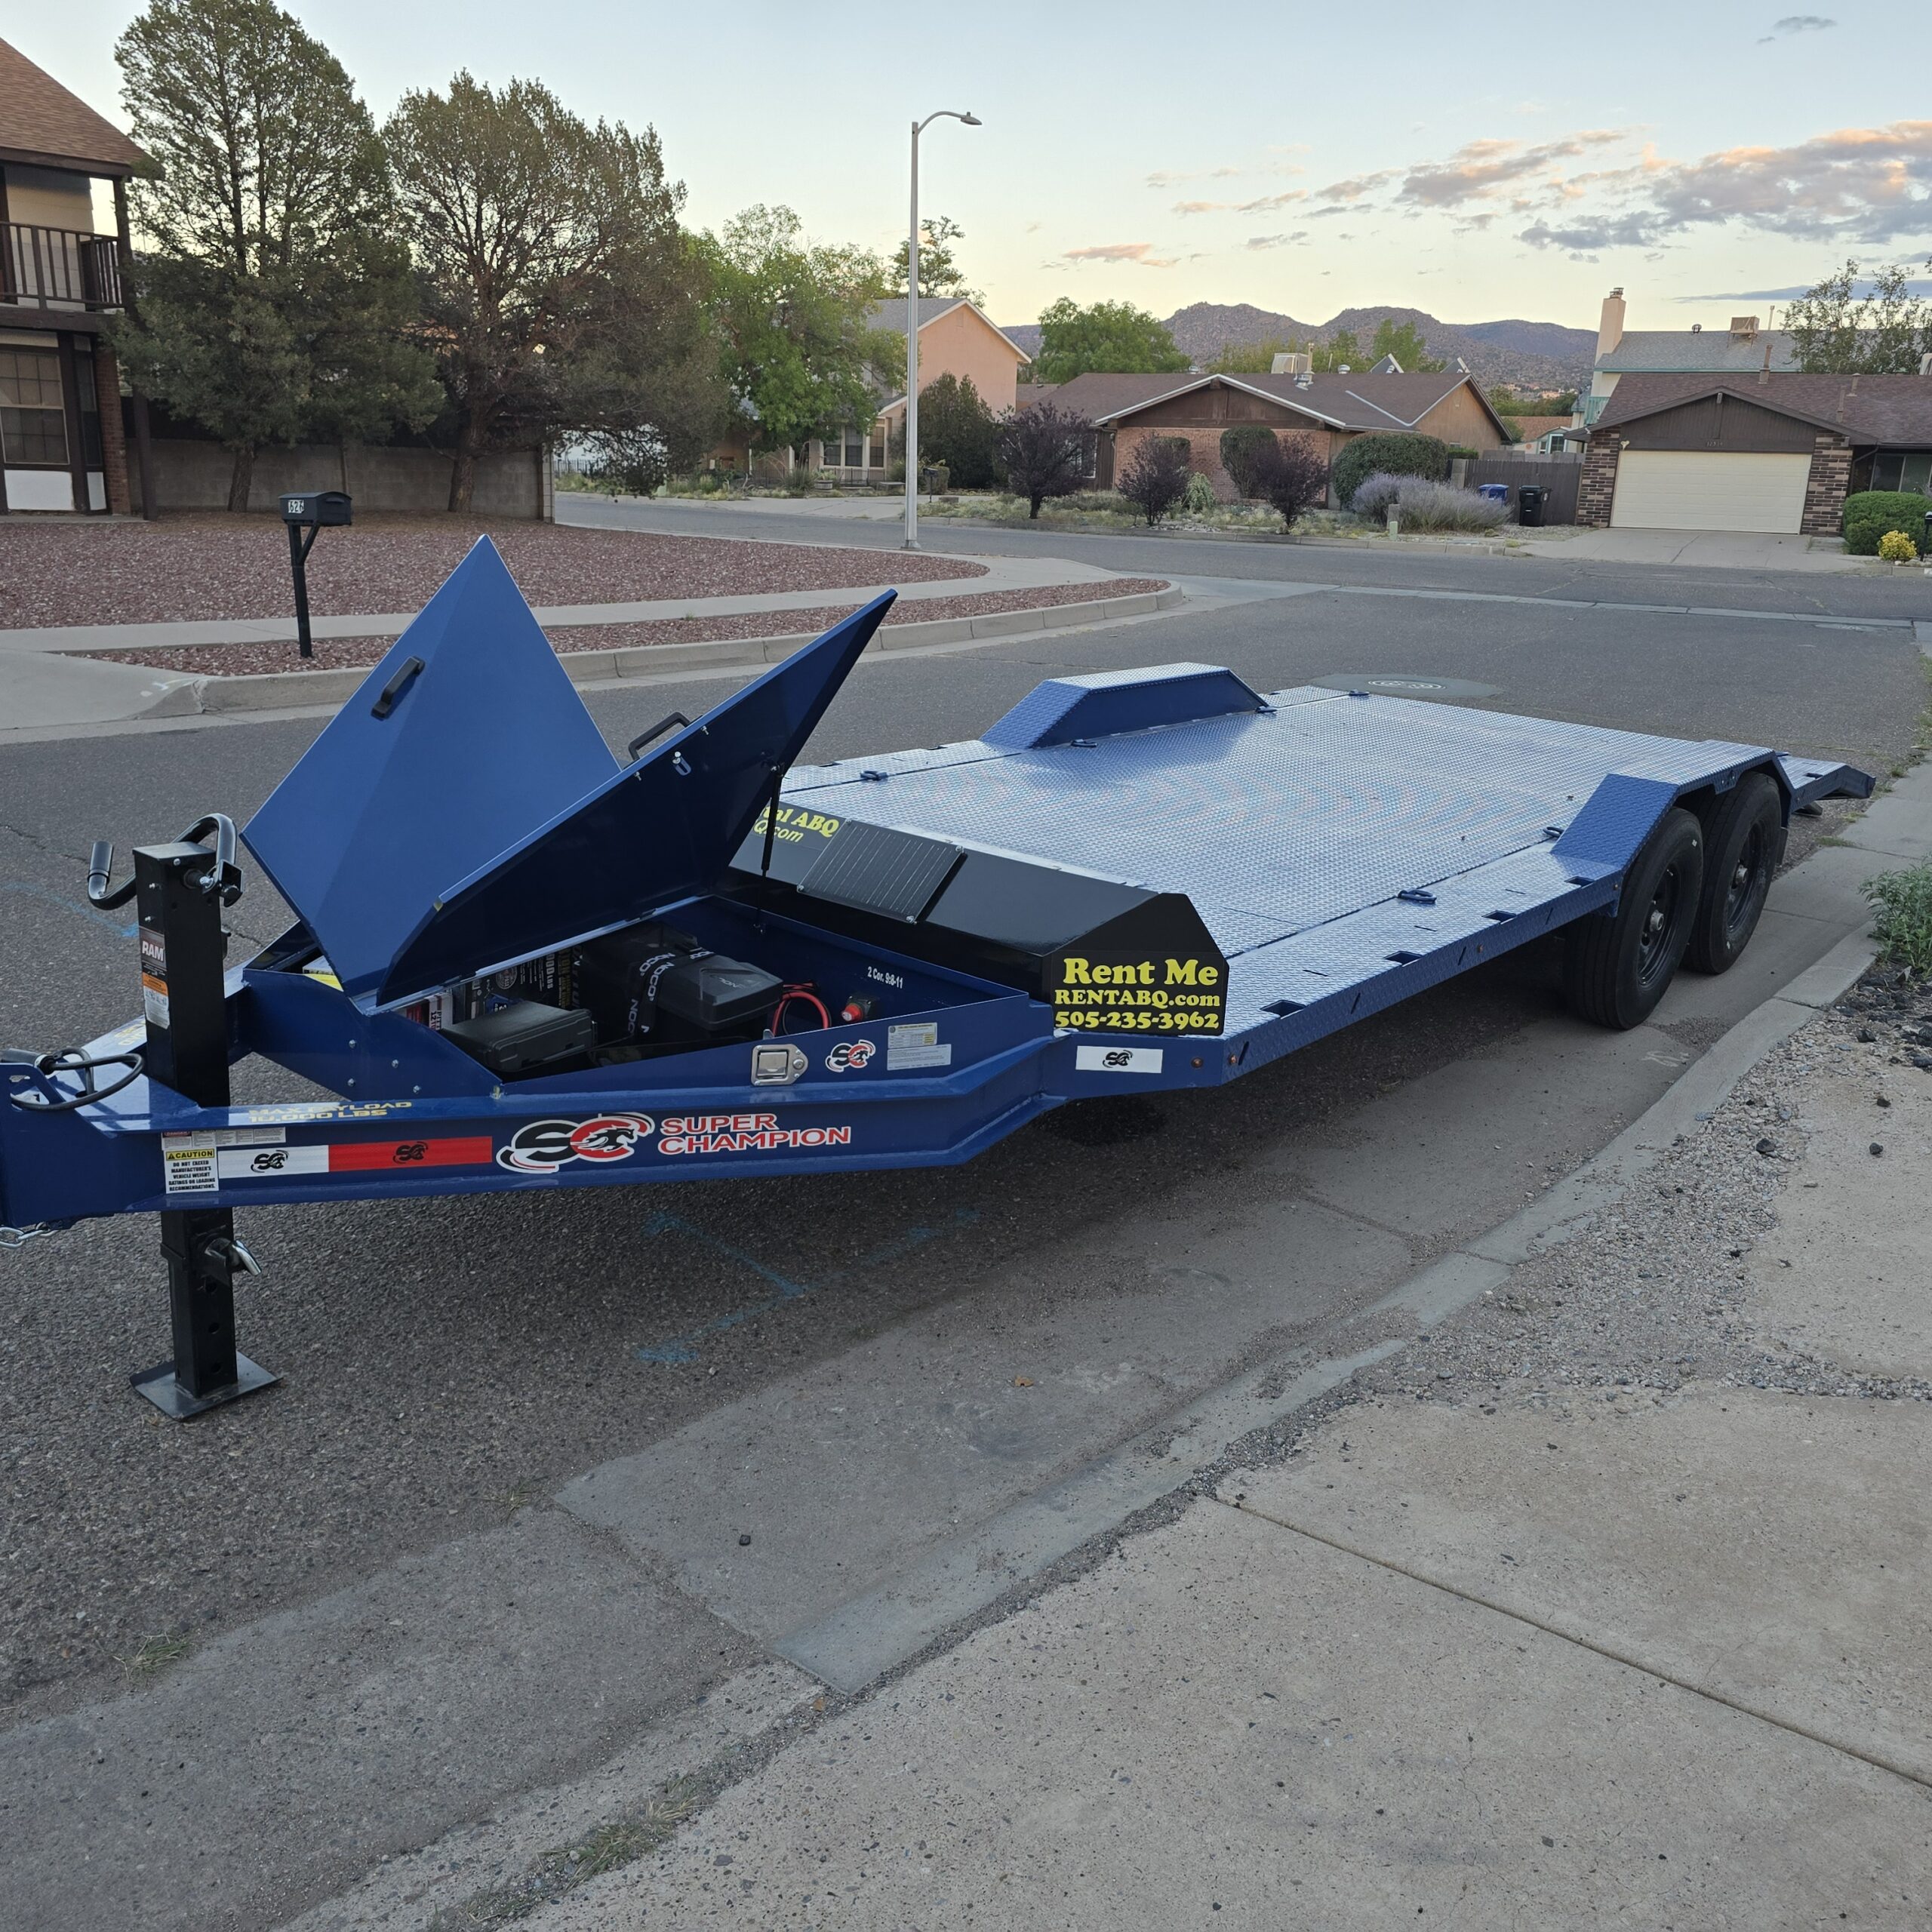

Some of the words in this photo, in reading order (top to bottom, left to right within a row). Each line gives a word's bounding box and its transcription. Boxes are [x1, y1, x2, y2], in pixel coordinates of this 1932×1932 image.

[791, 812, 839, 838] ABQ
[142, 940, 164, 961] RAM
[648, 961, 675, 998] NOCO
[867, 966, 872, 978] 2
[872, 968, 884, 983] Cor.
[885, 972, 903, 989] 9:8-11
[1063, 958, 1155, 984] Rent
[1164, 958, 1219, 986] Me
[1054, 989, 1220, 1009] RENTABQ.com
[1055, 1011, 1220, 1030] 505-235-3962
[308, 1102, 412, 1112] PAYLOAD
[338, 1109, 388, 1118] LBS
[659, 1113, 777, 1136] SUPER
[657, 1126, 851, 1156] CHAMPION
